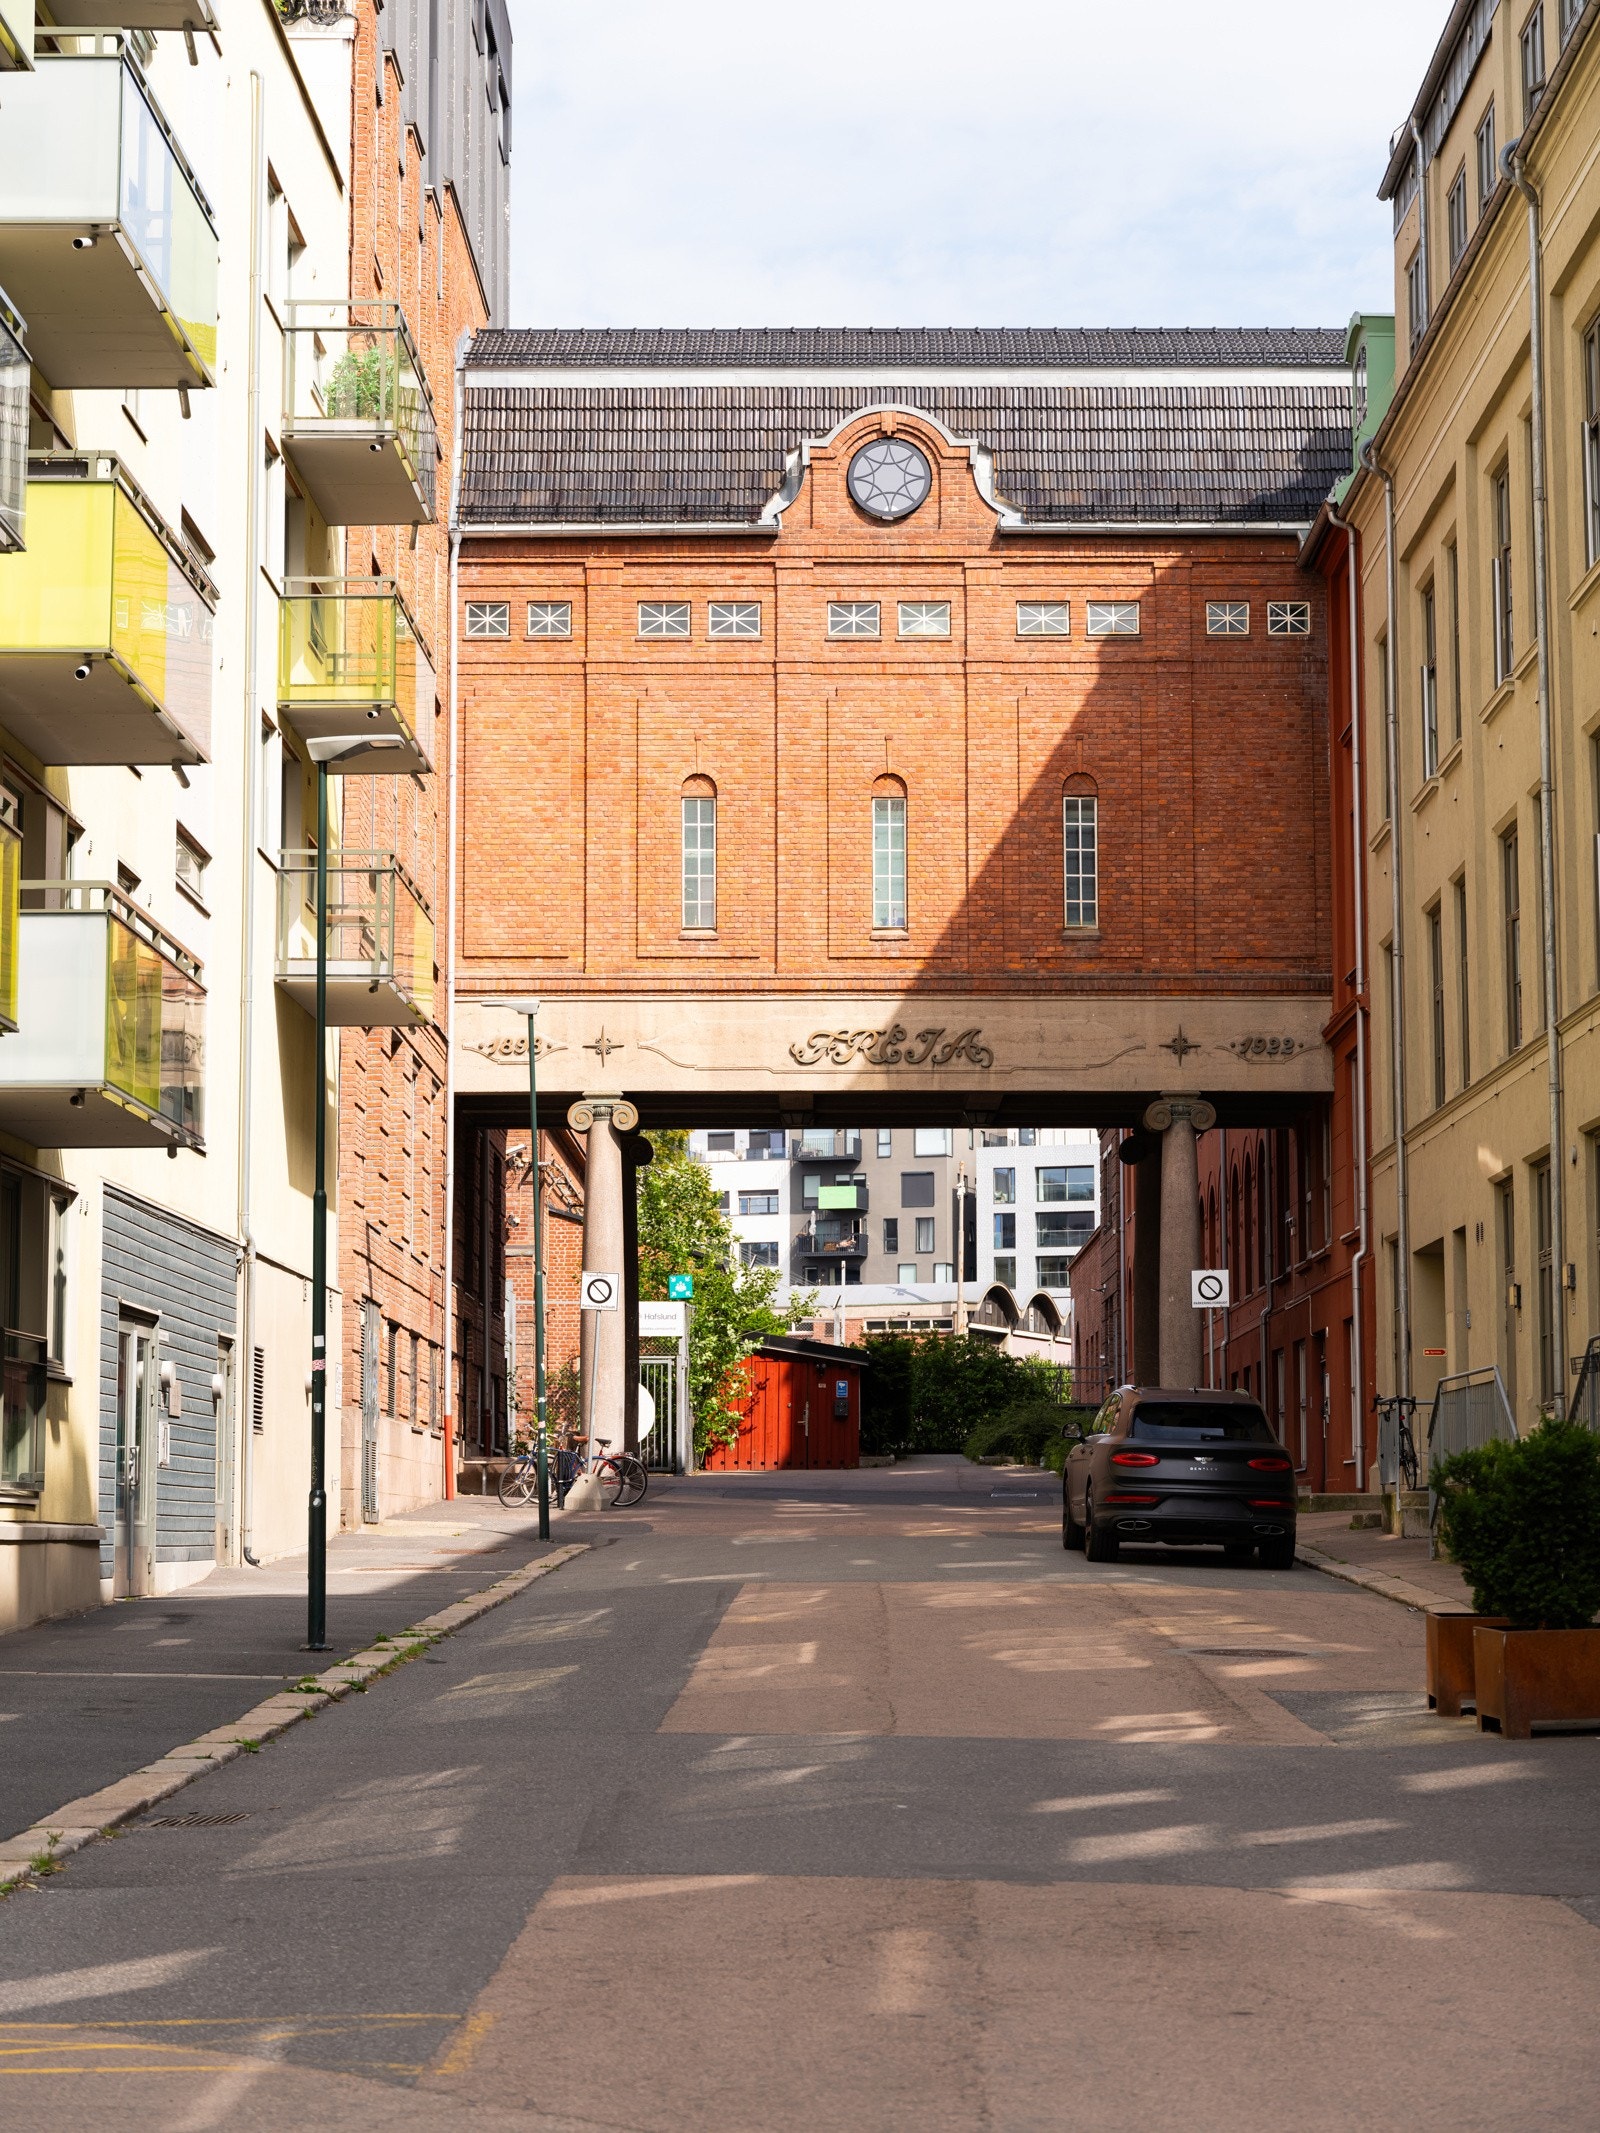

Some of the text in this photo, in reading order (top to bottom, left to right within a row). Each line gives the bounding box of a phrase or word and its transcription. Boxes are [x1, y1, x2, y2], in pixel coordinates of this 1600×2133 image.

[486, 1036, 543, 1056] 1898
[788, 1024, 994, 1068] FREIA
[1240, 1036, 1295, 1055] 1922
